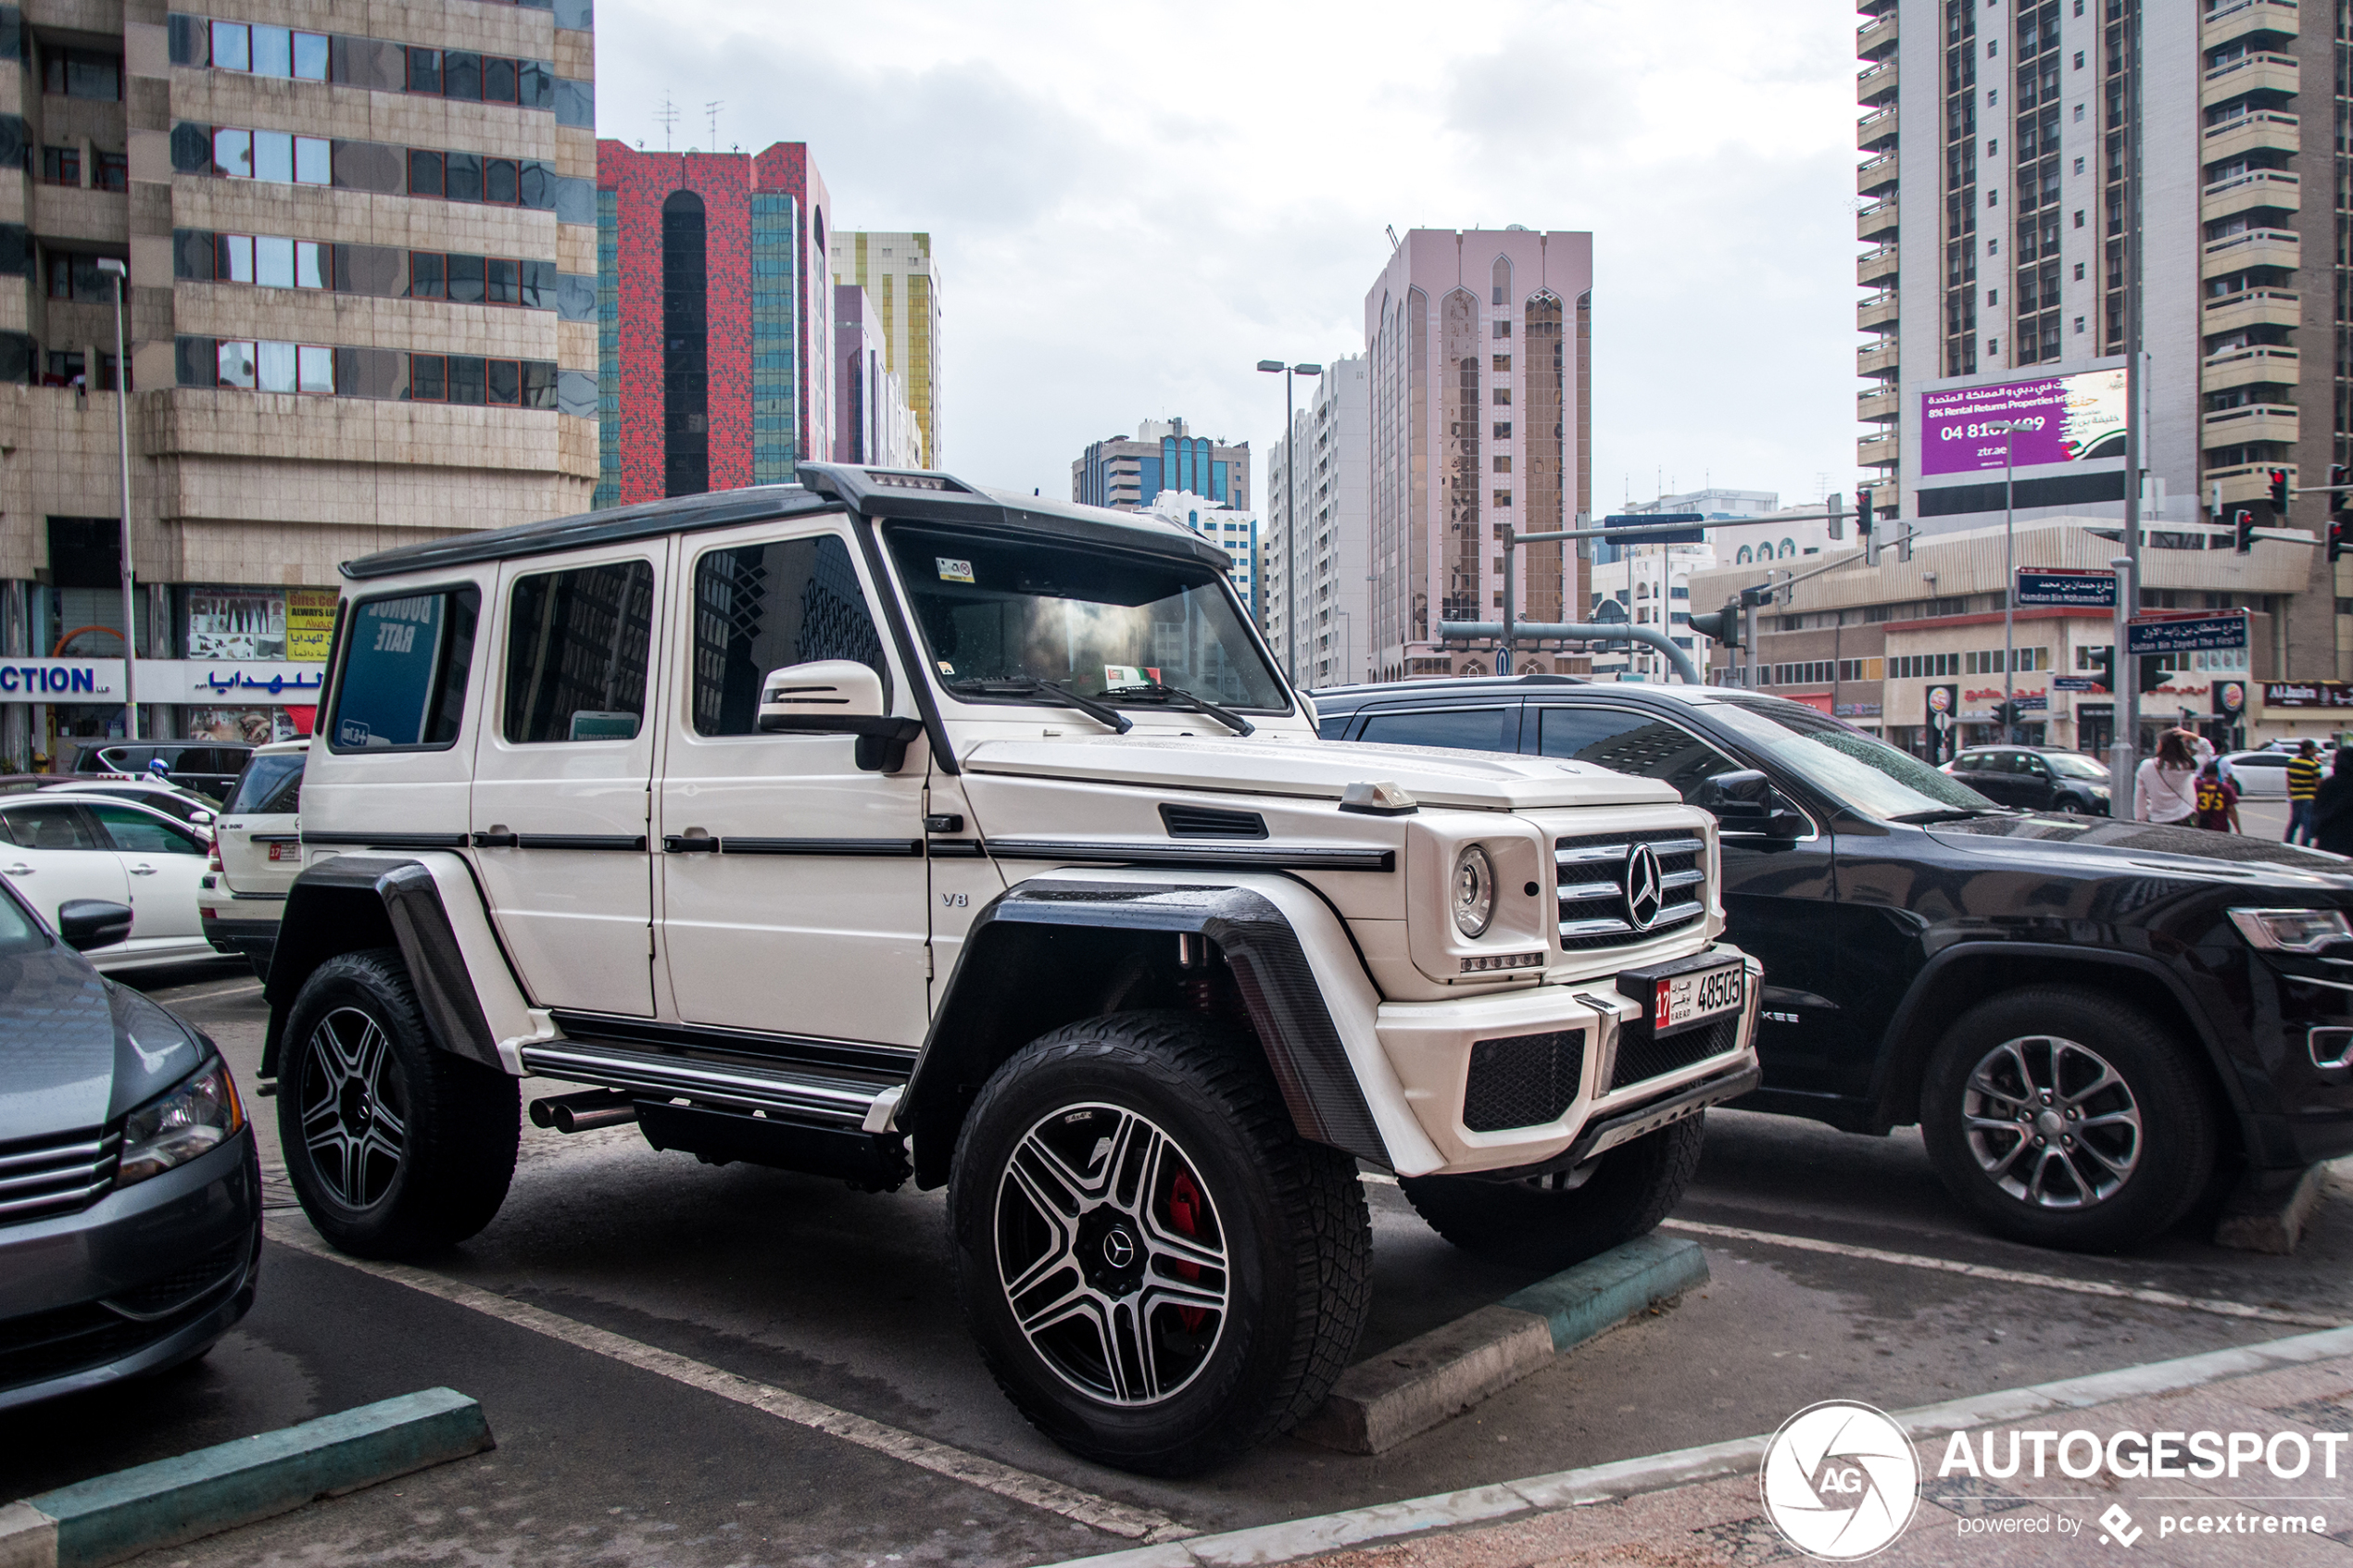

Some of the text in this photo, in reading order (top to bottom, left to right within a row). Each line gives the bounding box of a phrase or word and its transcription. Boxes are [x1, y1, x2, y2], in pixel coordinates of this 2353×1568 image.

[1928, 393, 1964, 405] المتحدة
[1928, 409, 1944, 419] 8%
[1944, 405, 1973, 417] Rental
[1974, 402, 2007, 414] Returns
[2008, 396, 2054, 410] Properties
[1941, 425, 1964, 441] 04
[1977, 446, 2007, 458] ztr.ae
[290, 595, 316, 607] Gifts
[2051, 593, 2062, 602] Bin
[291, 608, 324, 617] ALWAYS
[2131, 643, 2156, 651] Sultan
[2157, 641, 2171, 649] Bin
[2172, 639, 2197, 649] Zayed
[2198, 637, 2214, 646] The
[2216, 636, 2235, 645] First
[0, 666, 94, 693] CTION
[271, 847, 281, 858] 17
[940, 893, 968, 908] V8
[1655, 969, 1740, 1019] 17 48505
